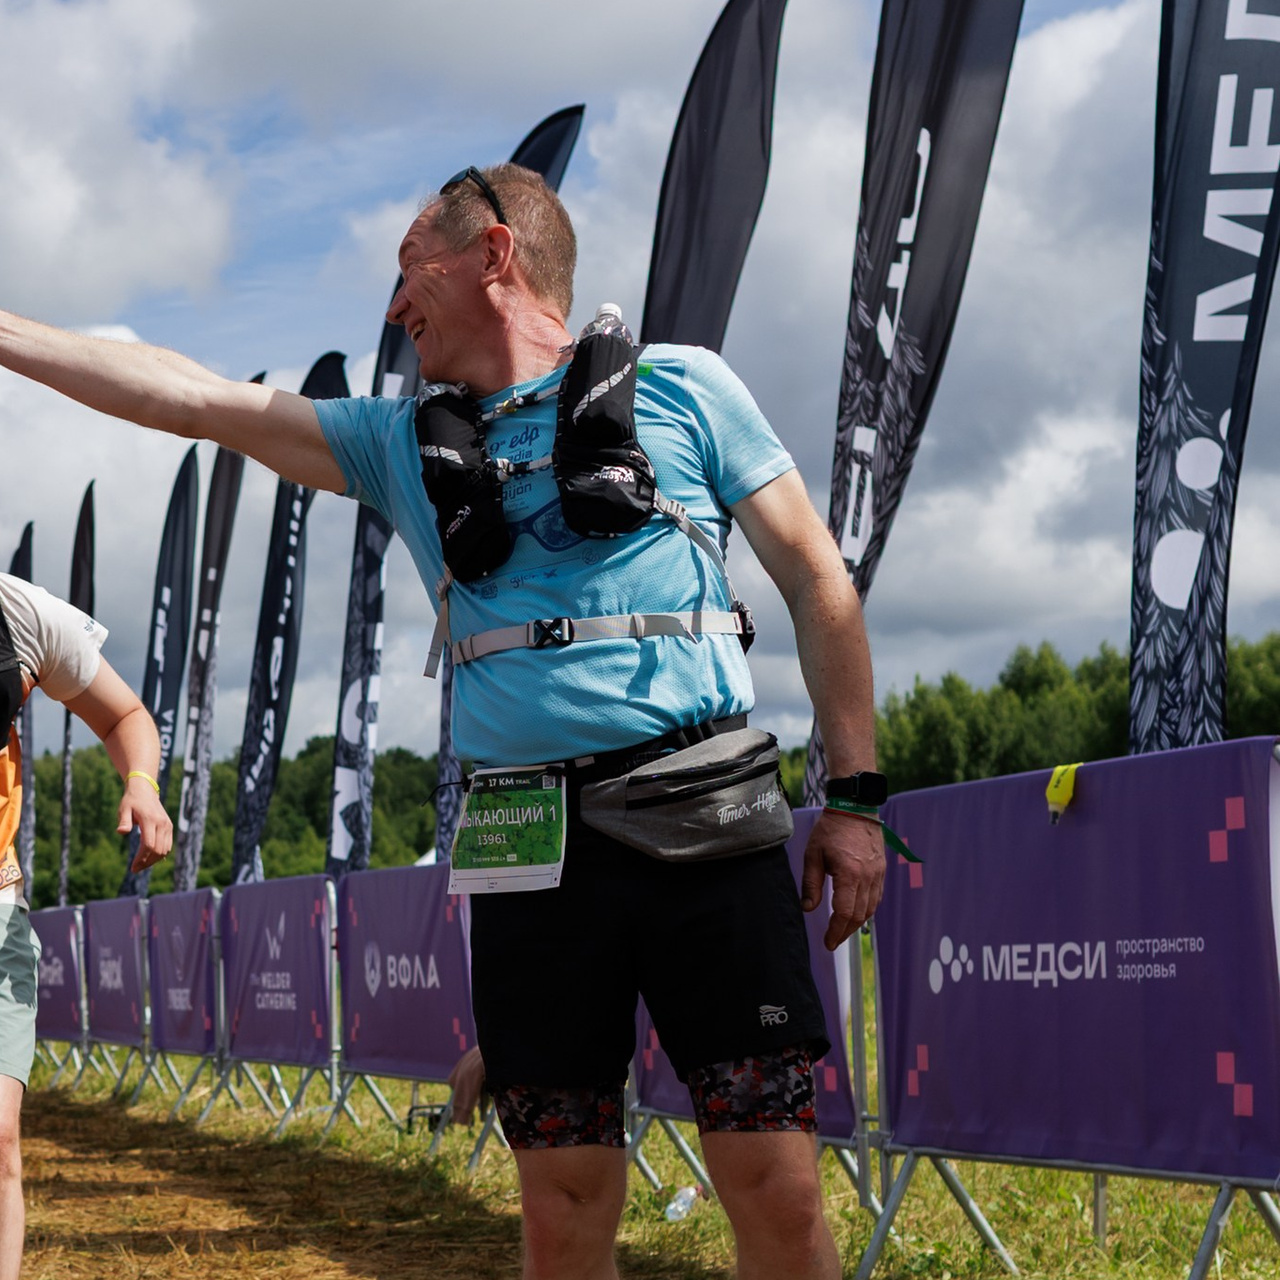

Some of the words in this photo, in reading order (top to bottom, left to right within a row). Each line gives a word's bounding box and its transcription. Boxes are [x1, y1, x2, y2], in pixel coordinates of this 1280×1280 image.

[477, 833, 508, 846] 13961
[982, 940, 1107, 988] МЕДСИ
[1115, 936, 1205, 958] пространство
[1116, 963, 1177, 984] здоровья
[760, 1011, 789, 1027] PRO
